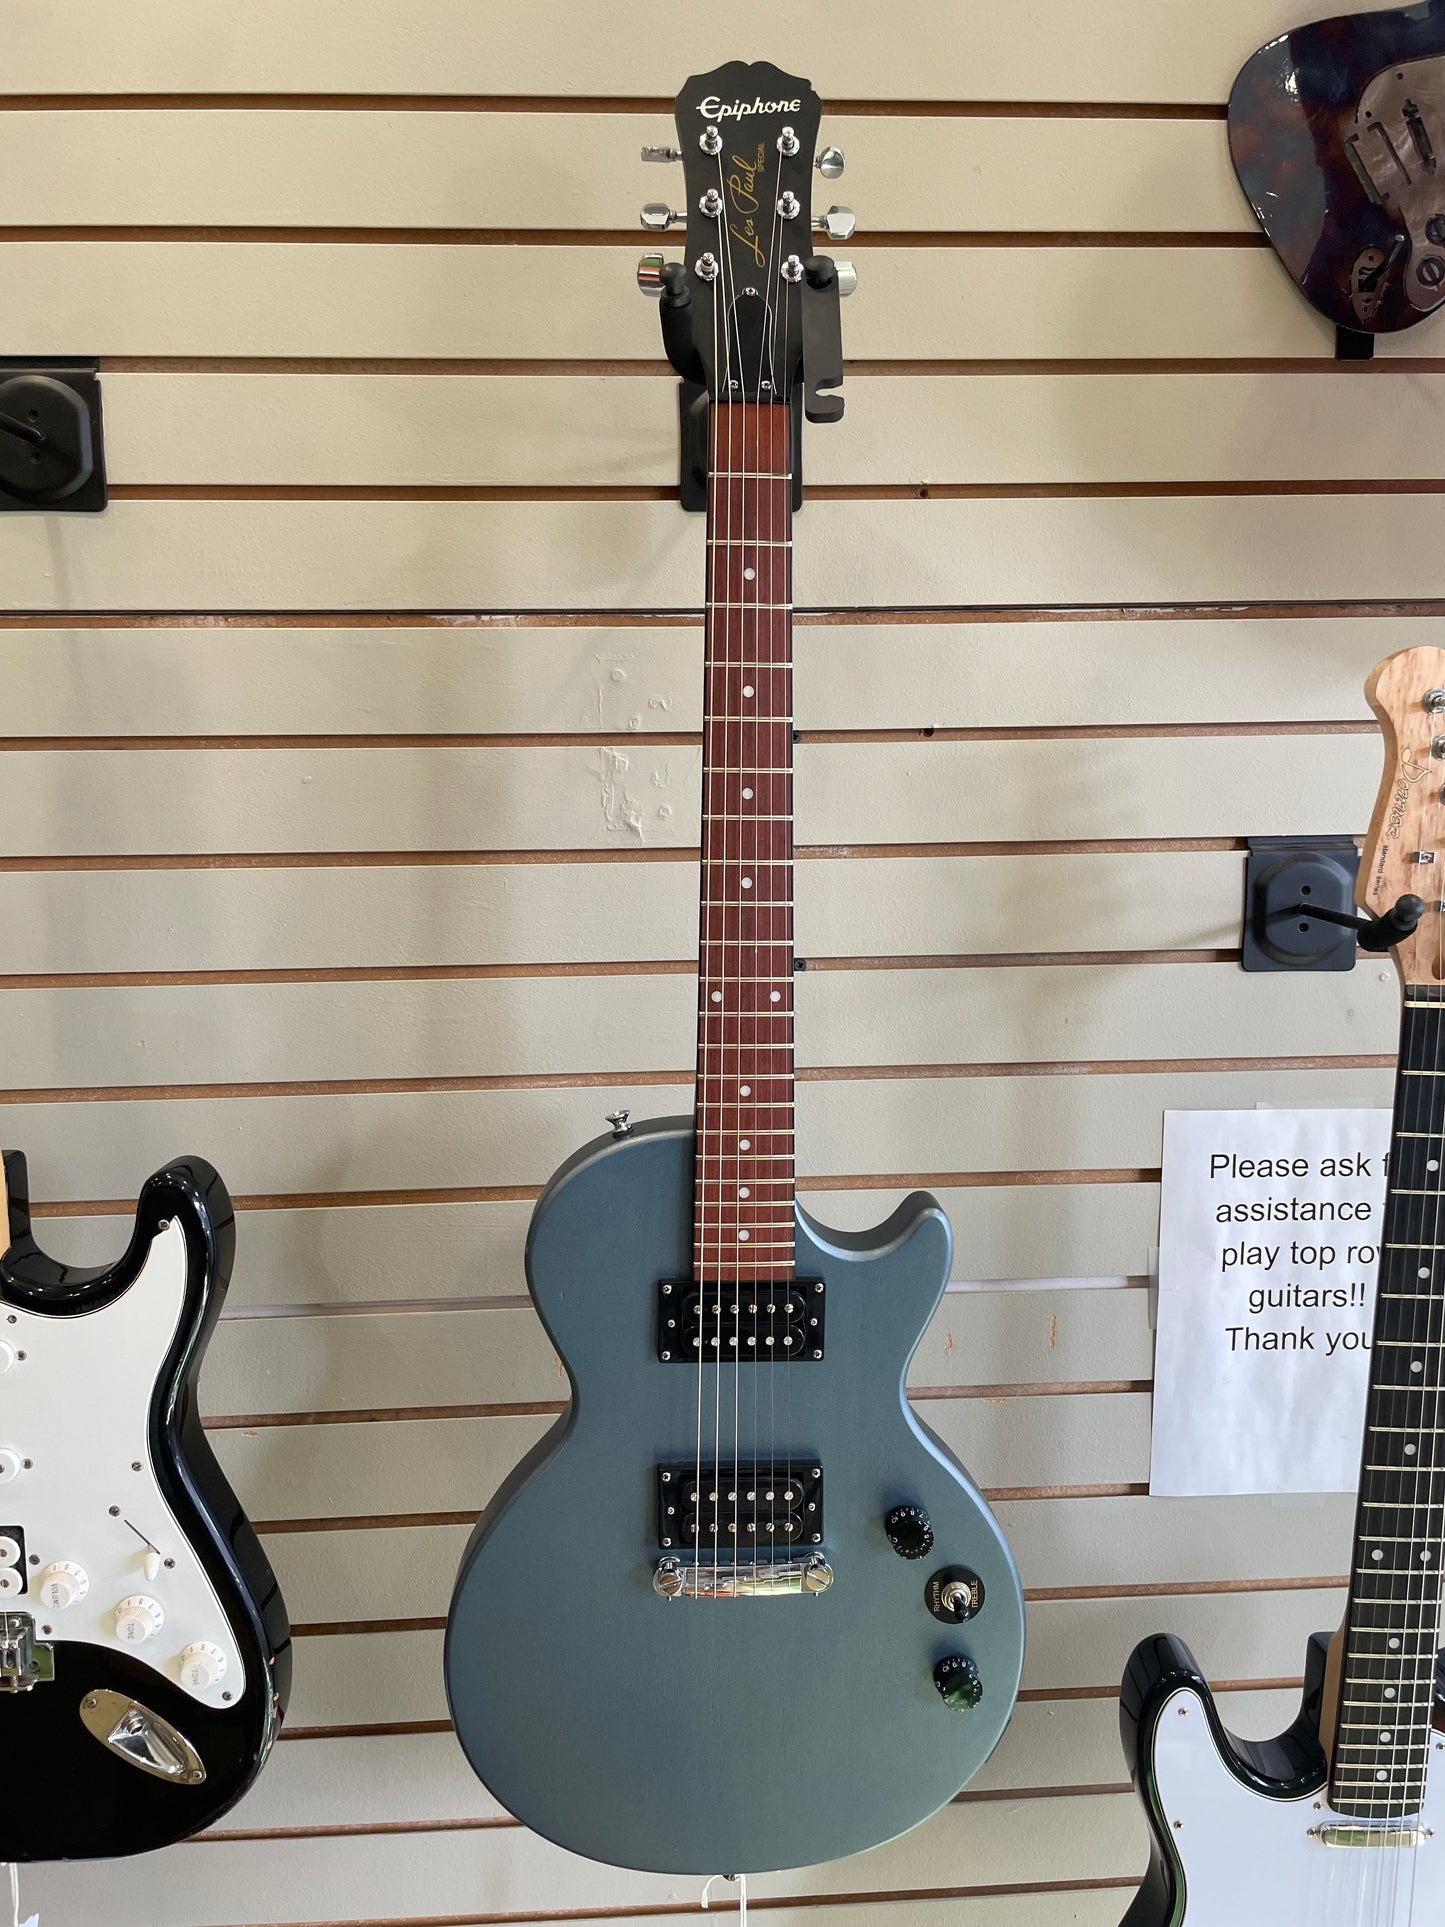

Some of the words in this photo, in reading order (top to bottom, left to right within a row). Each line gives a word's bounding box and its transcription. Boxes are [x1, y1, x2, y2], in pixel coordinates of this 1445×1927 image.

[696, 96, 802, 122] Epiphone
[757, 142, 765, 172] SPECIAL
[726, 155, 760, 215] Paul
[729, 218, 766, 268] Les
[1377, 844, 1389, 874] standard
[1372, 876, 1382, 896] series
[1211, 1154, 1308, 1178] Please
[1321, 1152, 1371, 1176] ask
[1217, 1197, 1371, 1222] assistance
[1222, 1242, 1280, 1272] play
[1291, 1241, 1335, 1270] top
[1347, 1246, 1380, 1264] ro
[1250, 1283, 1364, 1313] guitars!!
[1226, 1326, 1314, 1350] Thank
[1325, 1332, 1372, 1357] you
[127, 1623, 135, 1640] TONE
[191, 1669, 199, 1686] TONE
